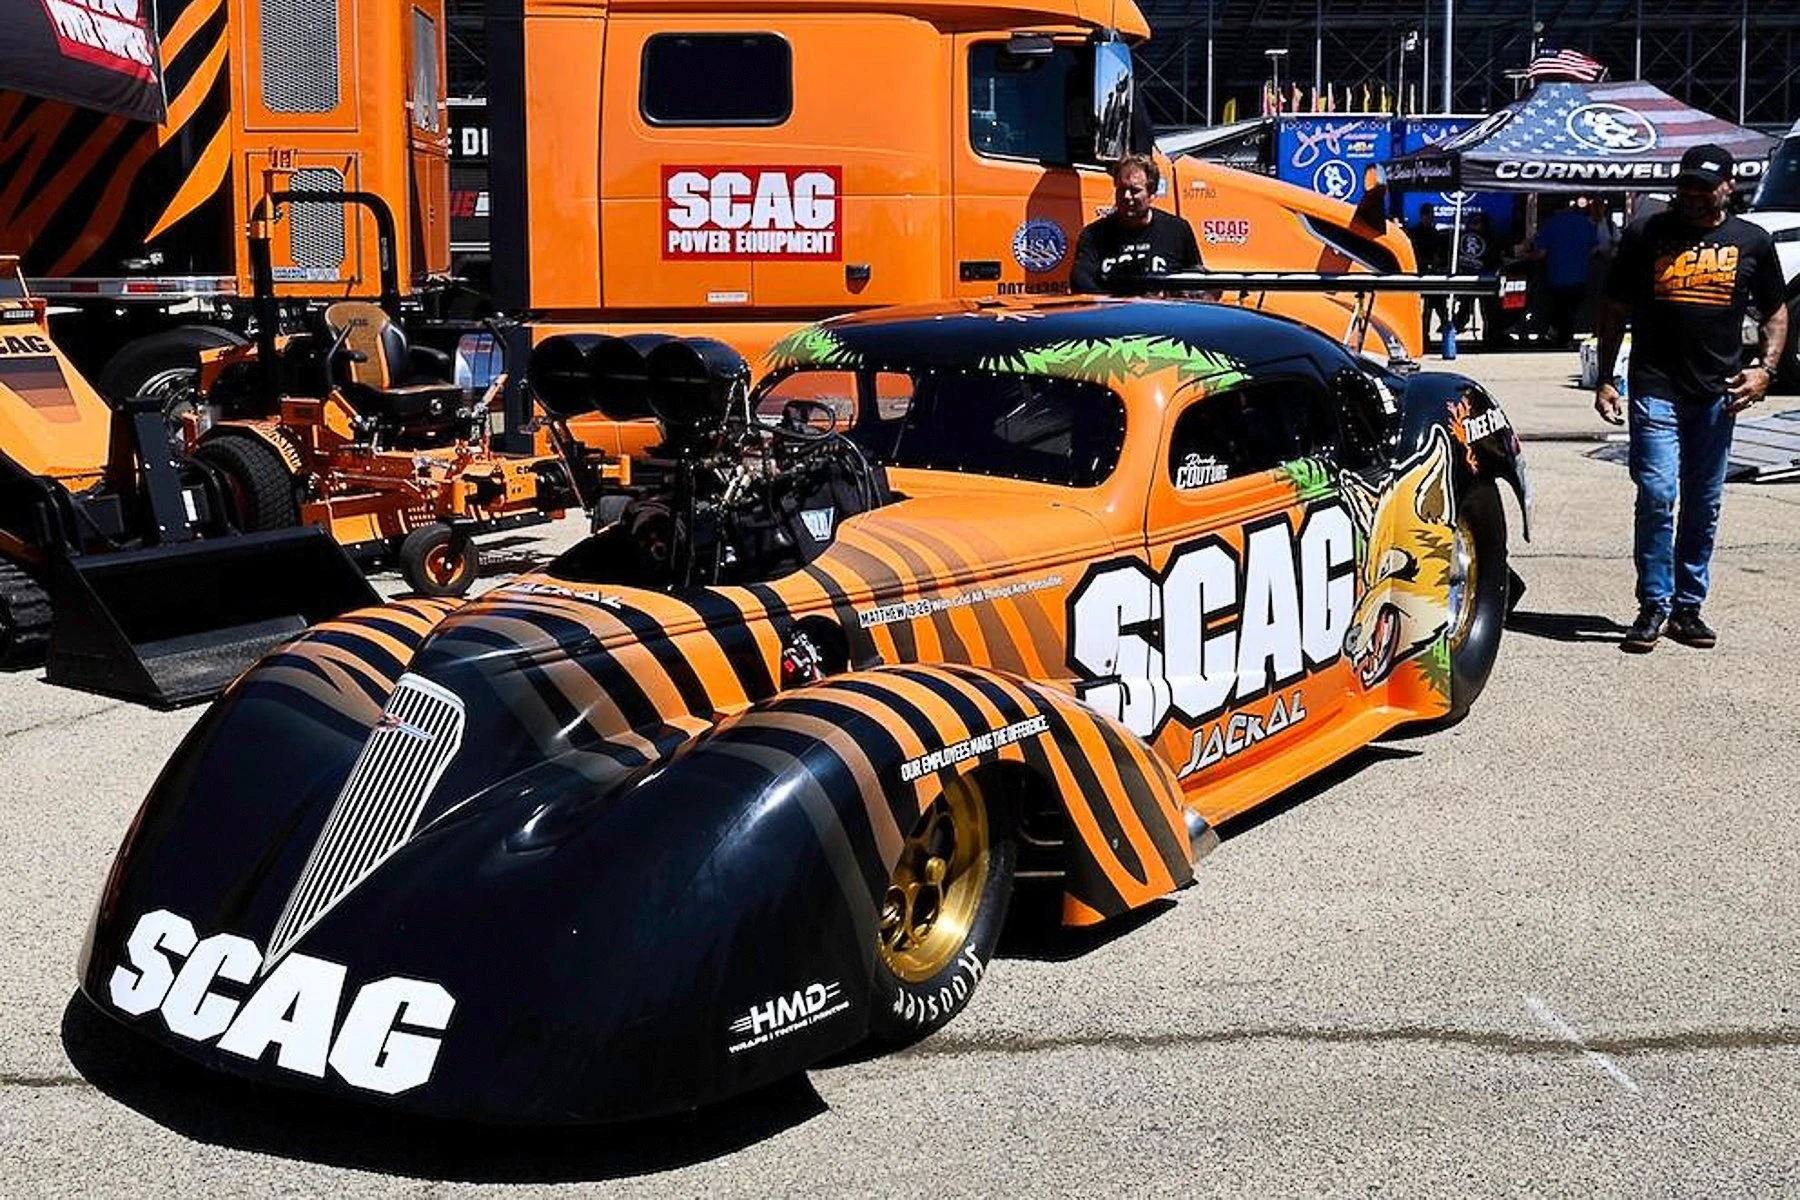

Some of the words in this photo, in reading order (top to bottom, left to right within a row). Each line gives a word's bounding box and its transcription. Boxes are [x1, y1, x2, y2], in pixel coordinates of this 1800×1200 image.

[667, 171, 836, 230] SCAG
[1203, 220, 1249, 235] SCAG
[668, 230, 731, 253] POWER
[735, 230, 836, 254] EQUIPMENT
[1073, 503, 1356, 739] SCAG
[901, 761, 923, 782] OUR
[921, 741, 971, 774] EMPLOYEES
[970, 732, 994, 756] MAKE
[993, 729, 1008, 749] THE
[1178, 691, 1307, 779] JACKAL
[109, 908, 457, 1096] SCAG
[749, 982, 827, 1036] HMD
